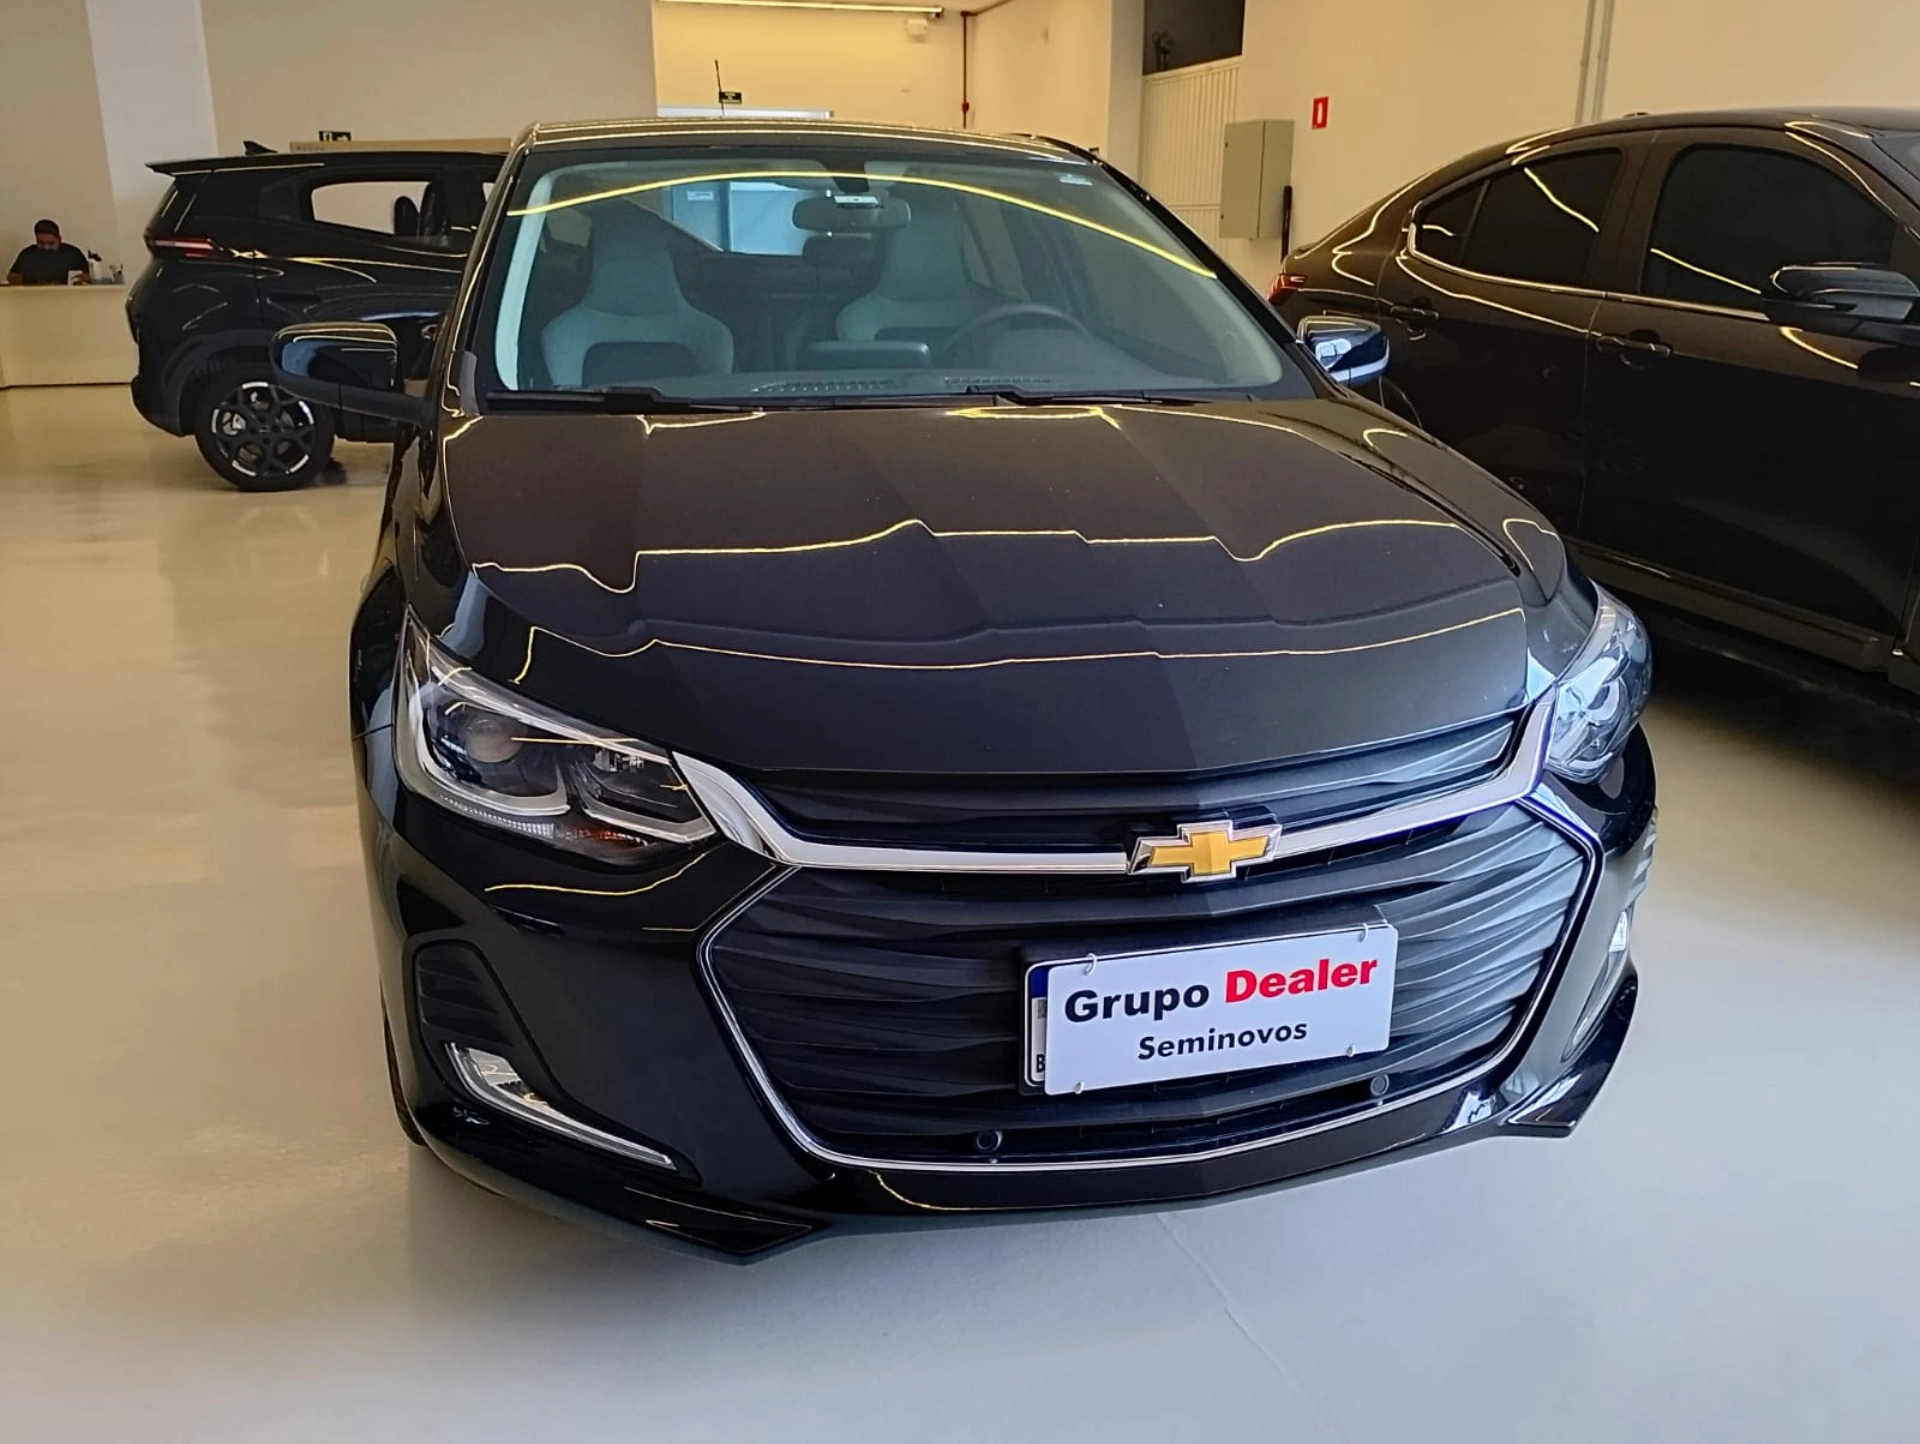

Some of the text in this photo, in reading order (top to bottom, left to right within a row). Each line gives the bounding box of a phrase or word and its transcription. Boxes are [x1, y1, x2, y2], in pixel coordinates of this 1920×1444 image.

[1065, 959, 1378, 1023] Grupo Dealer
[1138, 1022, 1308, 1060] Seminovos
